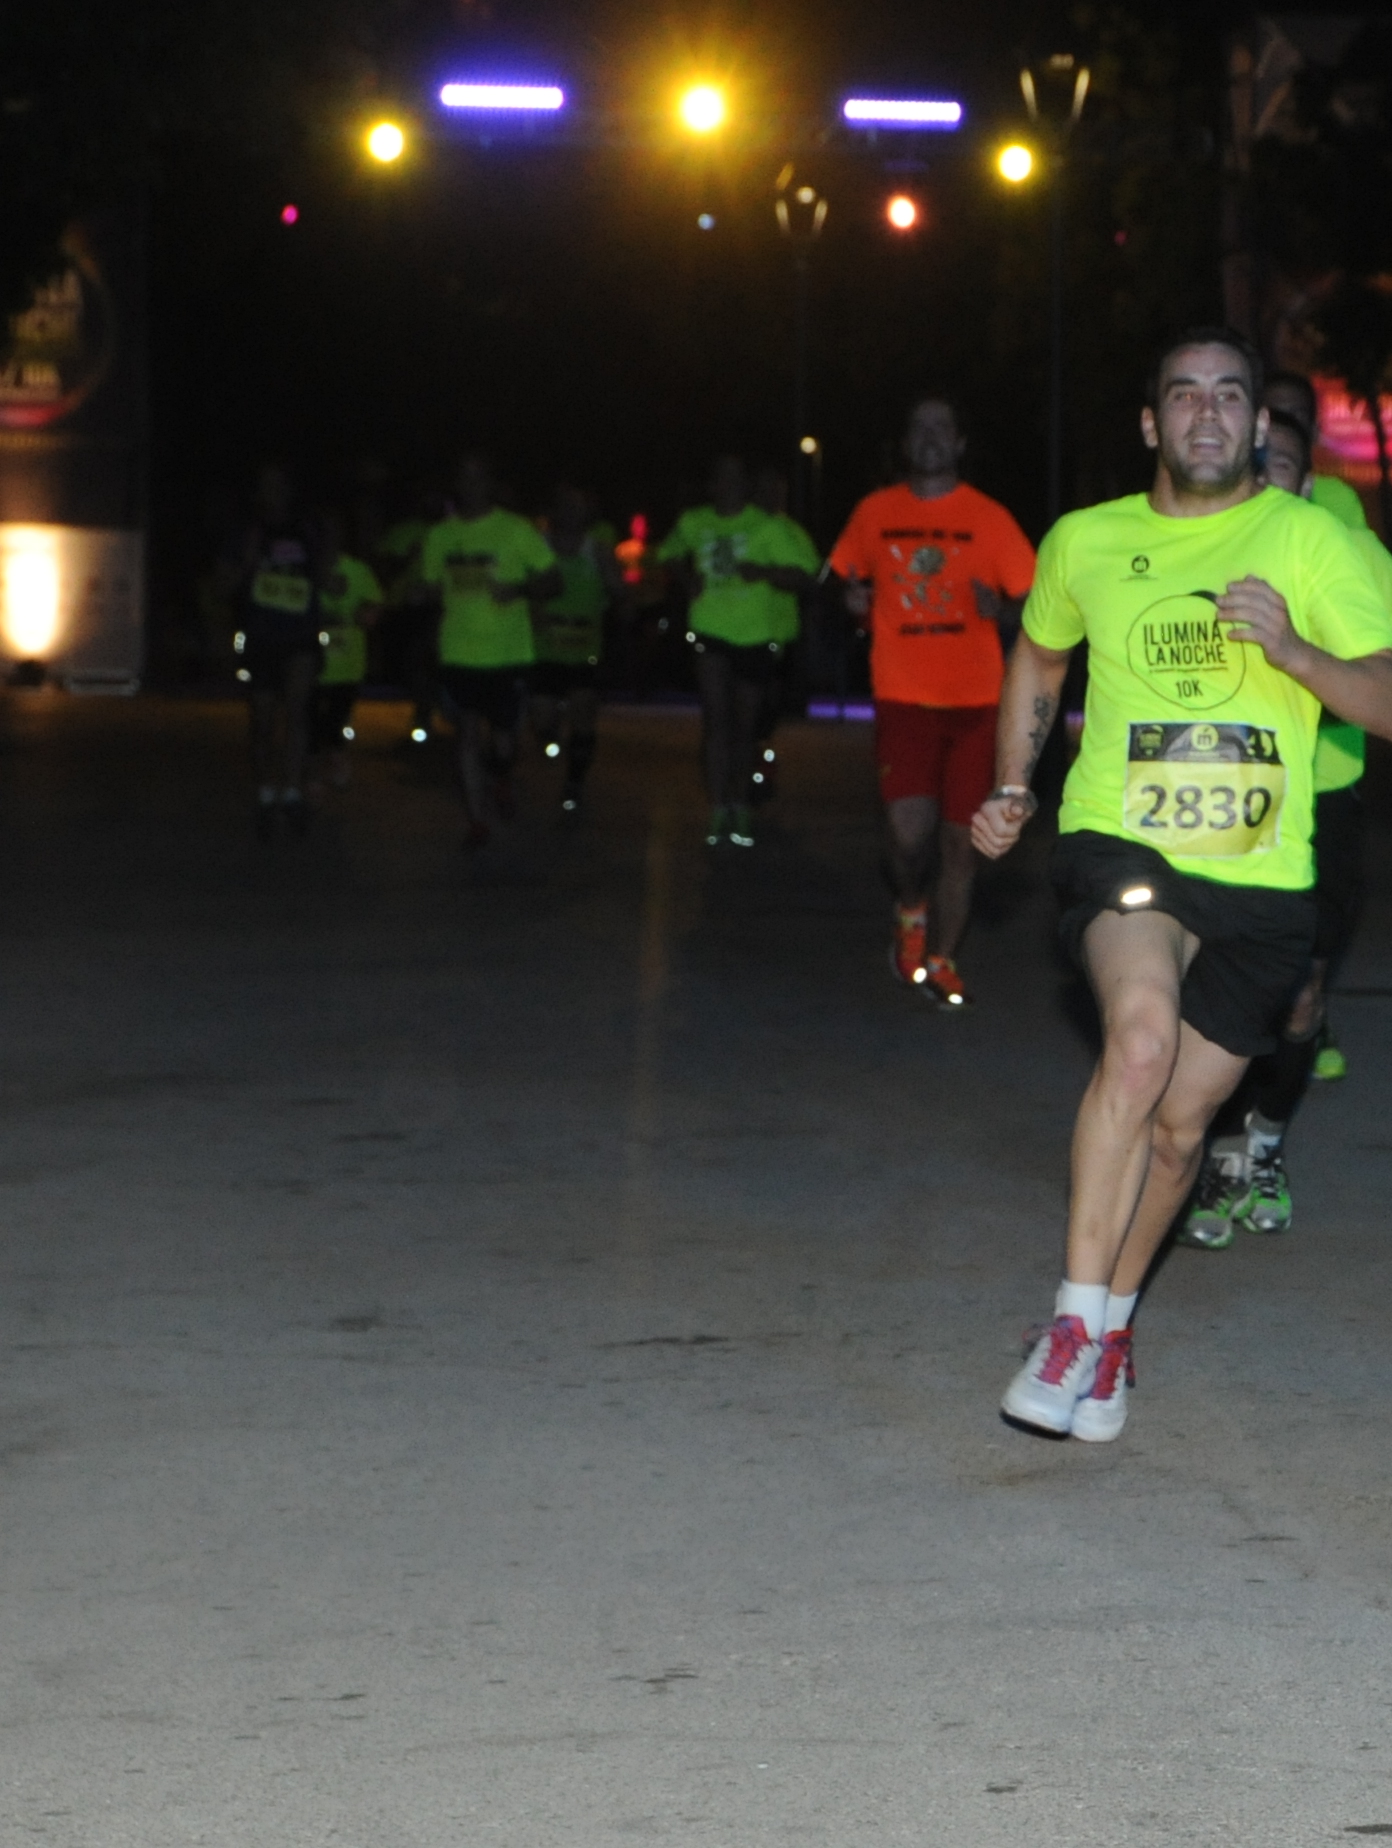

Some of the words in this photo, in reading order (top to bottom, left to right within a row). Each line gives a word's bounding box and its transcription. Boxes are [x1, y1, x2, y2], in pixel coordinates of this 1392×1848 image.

[1143, 619, 1223, 645] ILUMINA
[1176, 680, 1203, 698] 10K
[1139, 785, 1272, 830] 2830
